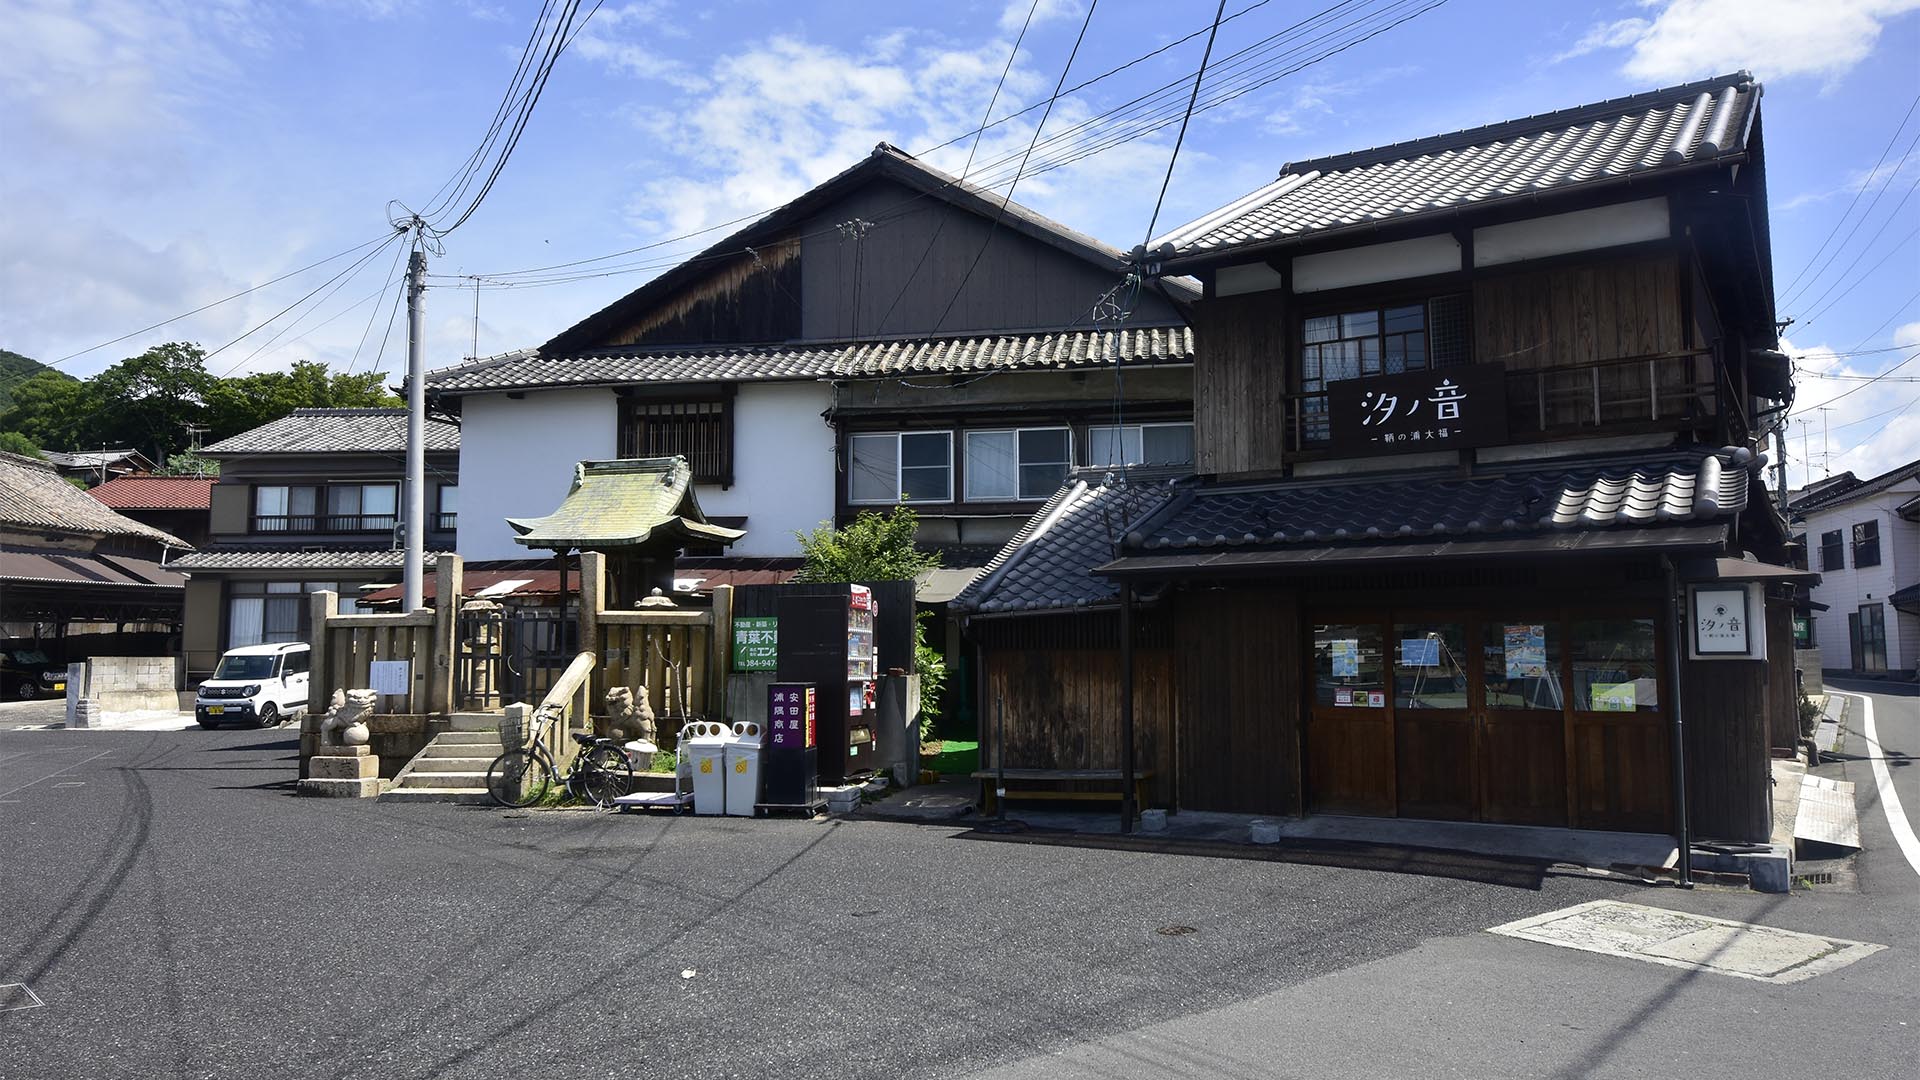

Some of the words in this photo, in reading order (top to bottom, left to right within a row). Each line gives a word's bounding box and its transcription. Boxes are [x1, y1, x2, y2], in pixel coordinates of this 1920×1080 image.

[1361, 378, 1467, 426] 汐ノ音
[789, 692, 799, 730] 安田屋
